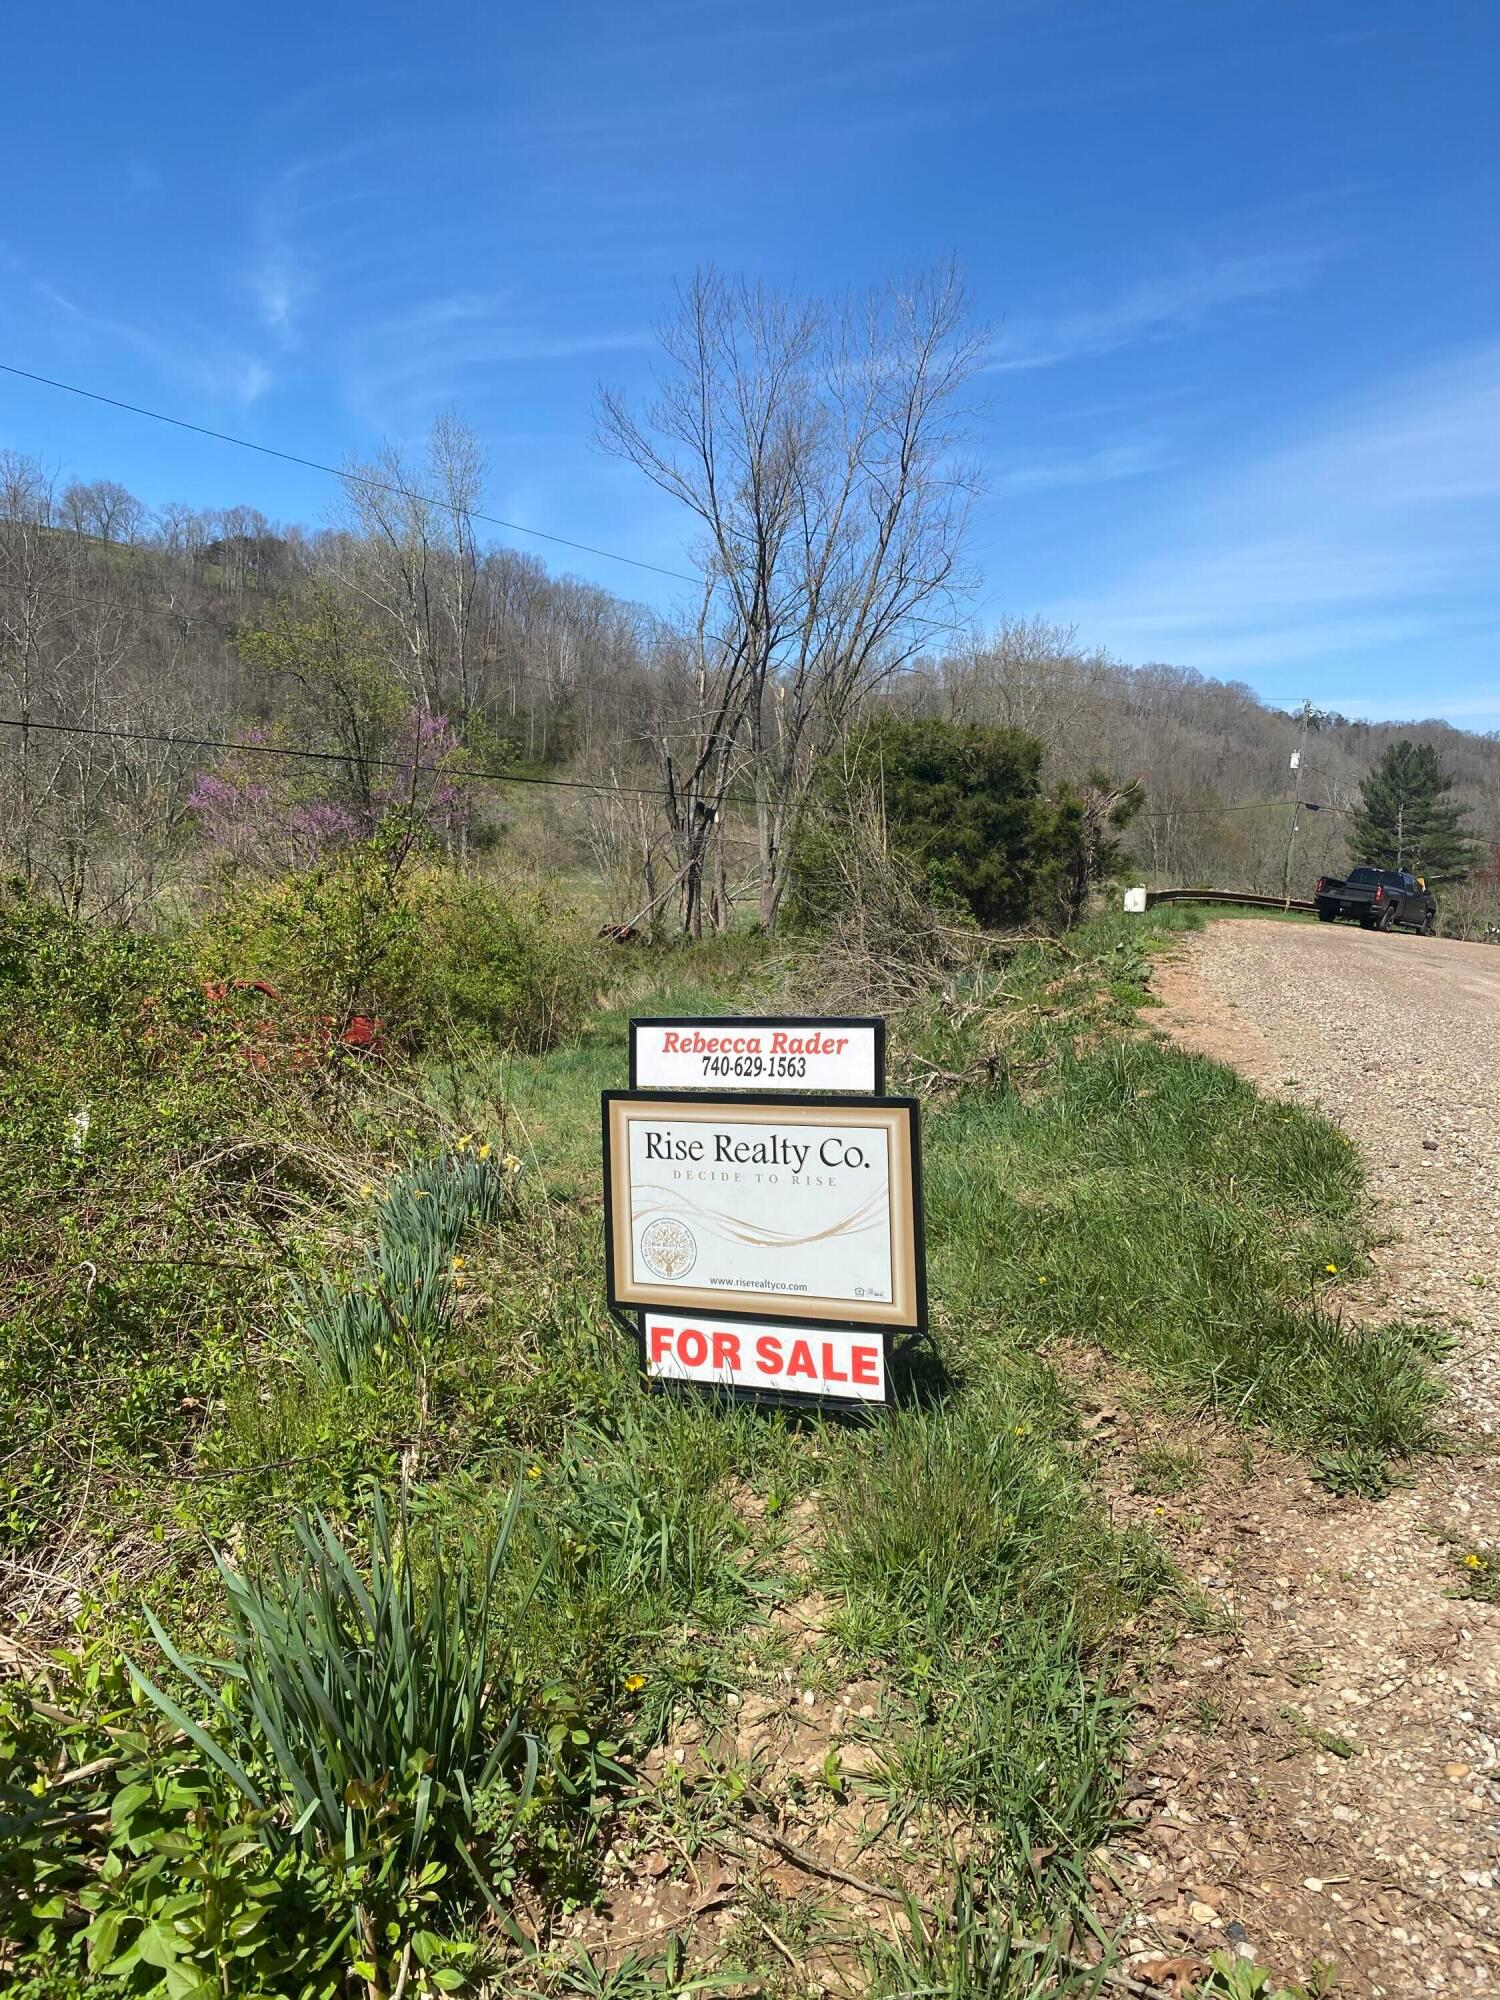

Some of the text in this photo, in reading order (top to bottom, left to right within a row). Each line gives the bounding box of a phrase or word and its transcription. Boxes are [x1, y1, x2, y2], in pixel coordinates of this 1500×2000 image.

[662, 1032, 849, 1055] Rebecca Rader
[702, 1056, 806, 1077] 740-629-1563
[645, 1131, 870, 1174] Rise Realty Co.
[673, 1169, 837, 1187] DECIDE TO RISE
[709, 1276, 808, 1292] www.riserealtyco.com
[651, 1326, 879, 1385] FOR SALE
